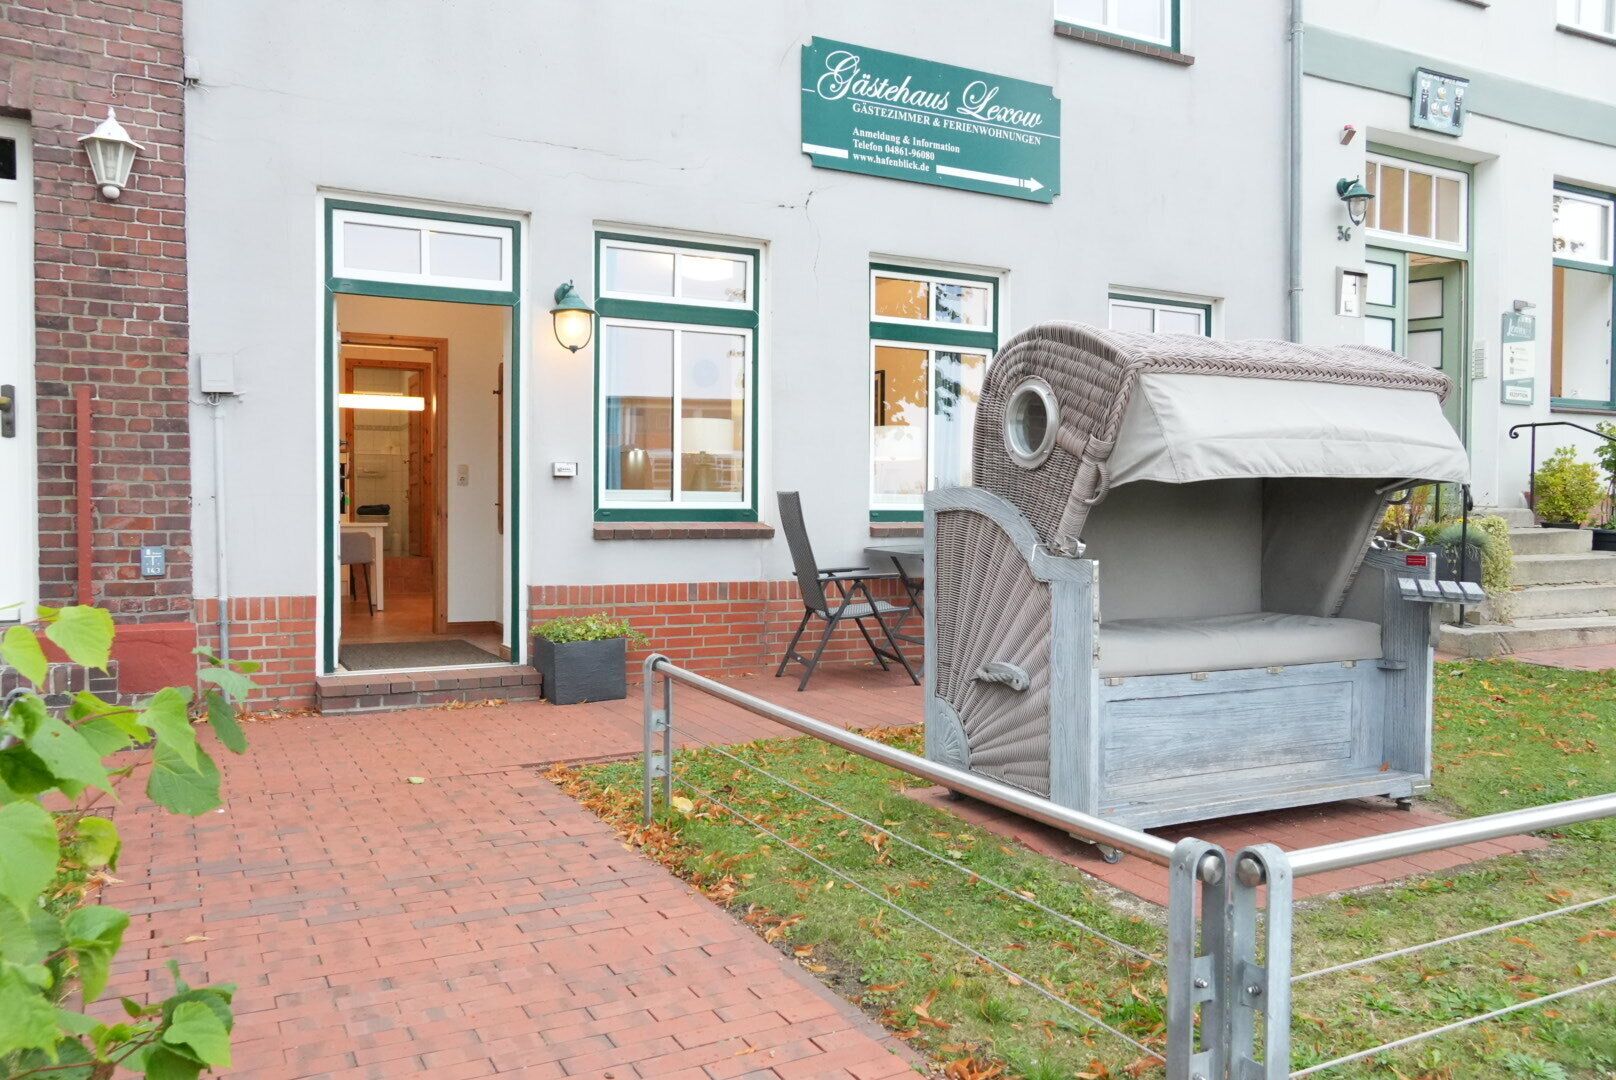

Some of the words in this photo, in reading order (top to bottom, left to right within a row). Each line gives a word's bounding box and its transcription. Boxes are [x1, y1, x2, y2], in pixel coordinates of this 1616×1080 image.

[817, 50, 950, 111] Gästehaus
[956, 80, 1043, 128] Lexow
[852, 102, 931, 126] GÄSTEZIMMER
[932, 117, 941, 127] &
[943, 119, 1042, 145] FERIENWOHNUNGEN
[852, 127, 901, 145] Anmeldung
[902, 135, 911, 145] &
[912, 137, 960, 153] Information
[852, 139, 883, 153] Telefon
[885, 144, 935, 160] 04861-96080
[852, 153, 930, 172] www.hafenblick.de
[1337, 225, 1351, 242] 36
